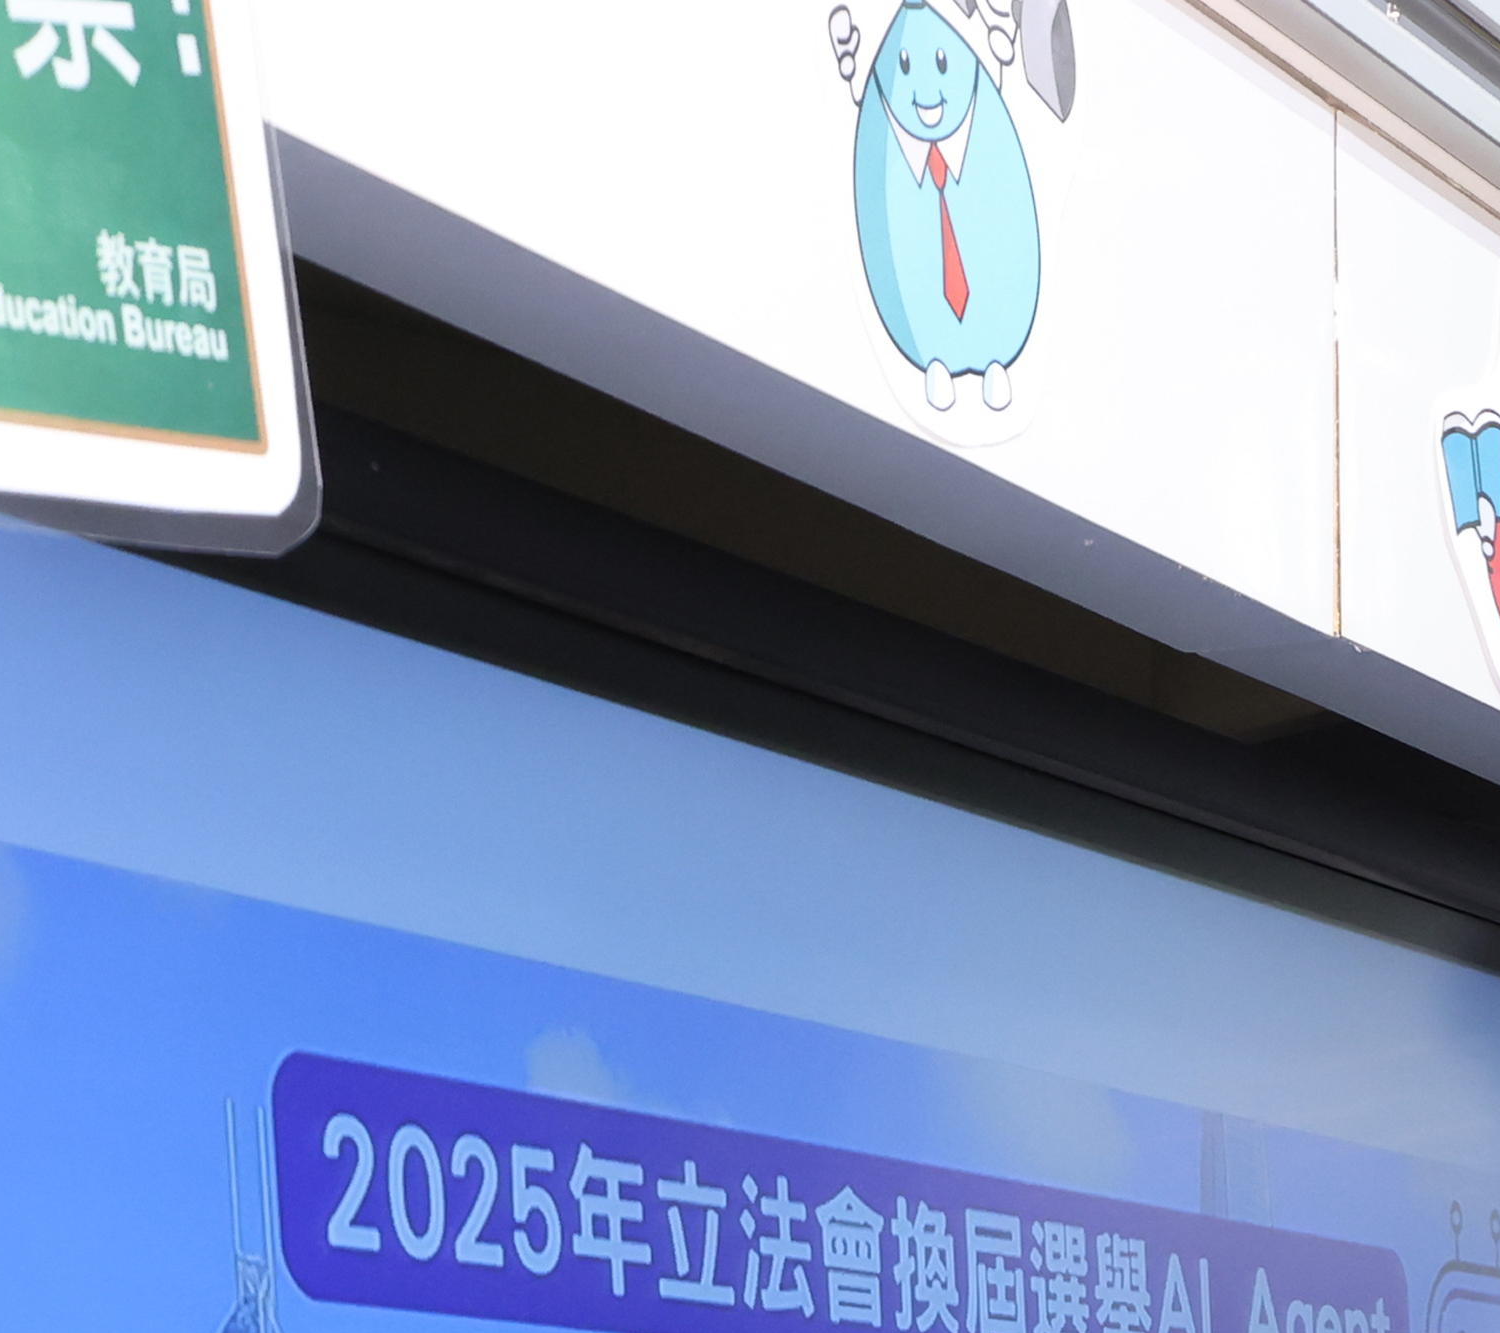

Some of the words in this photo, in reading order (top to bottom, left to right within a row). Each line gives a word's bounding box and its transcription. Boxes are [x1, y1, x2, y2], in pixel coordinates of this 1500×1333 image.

[96, 228, 218, 313] 教育局
[122, 303, 230, 362] Bureau
